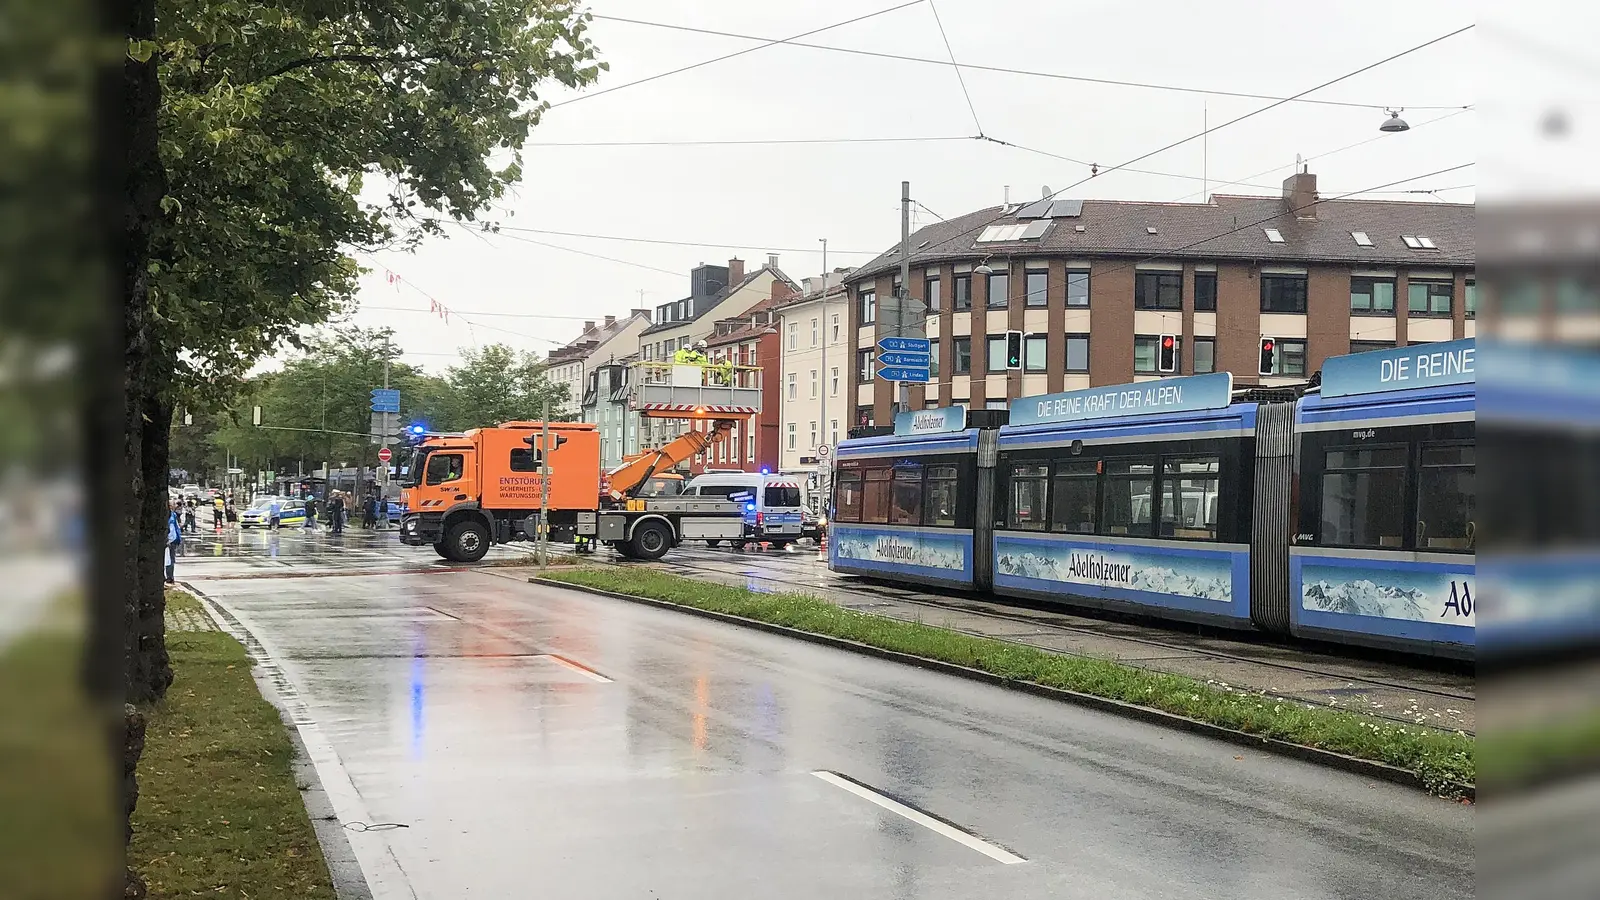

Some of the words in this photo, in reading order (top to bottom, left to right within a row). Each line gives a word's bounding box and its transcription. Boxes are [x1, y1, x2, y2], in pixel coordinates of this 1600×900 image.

[1380, 357, 1410, 383] DIE
[1416, 349, 1475, 379] REINE
[1037, 401, 1052, 418] DIE
[1053, 397, 1082, 416] REINE
[1083, 392, 1118, 413] KRAFT
[1119, 390, 1141, 409] DER
[1143, 385, 1184, 407] ALPEN.
[912, 413, 944, 431] Adelholzener
[1352, 428, 1376, 441] mvg.de
[876, 538, 913, 560] Adelholzener
[1297, 533, 1314, 541] MVG
[1067, 552, 1131, 583] Adelholzener
[1440, 581, 1475, 617] Ad
